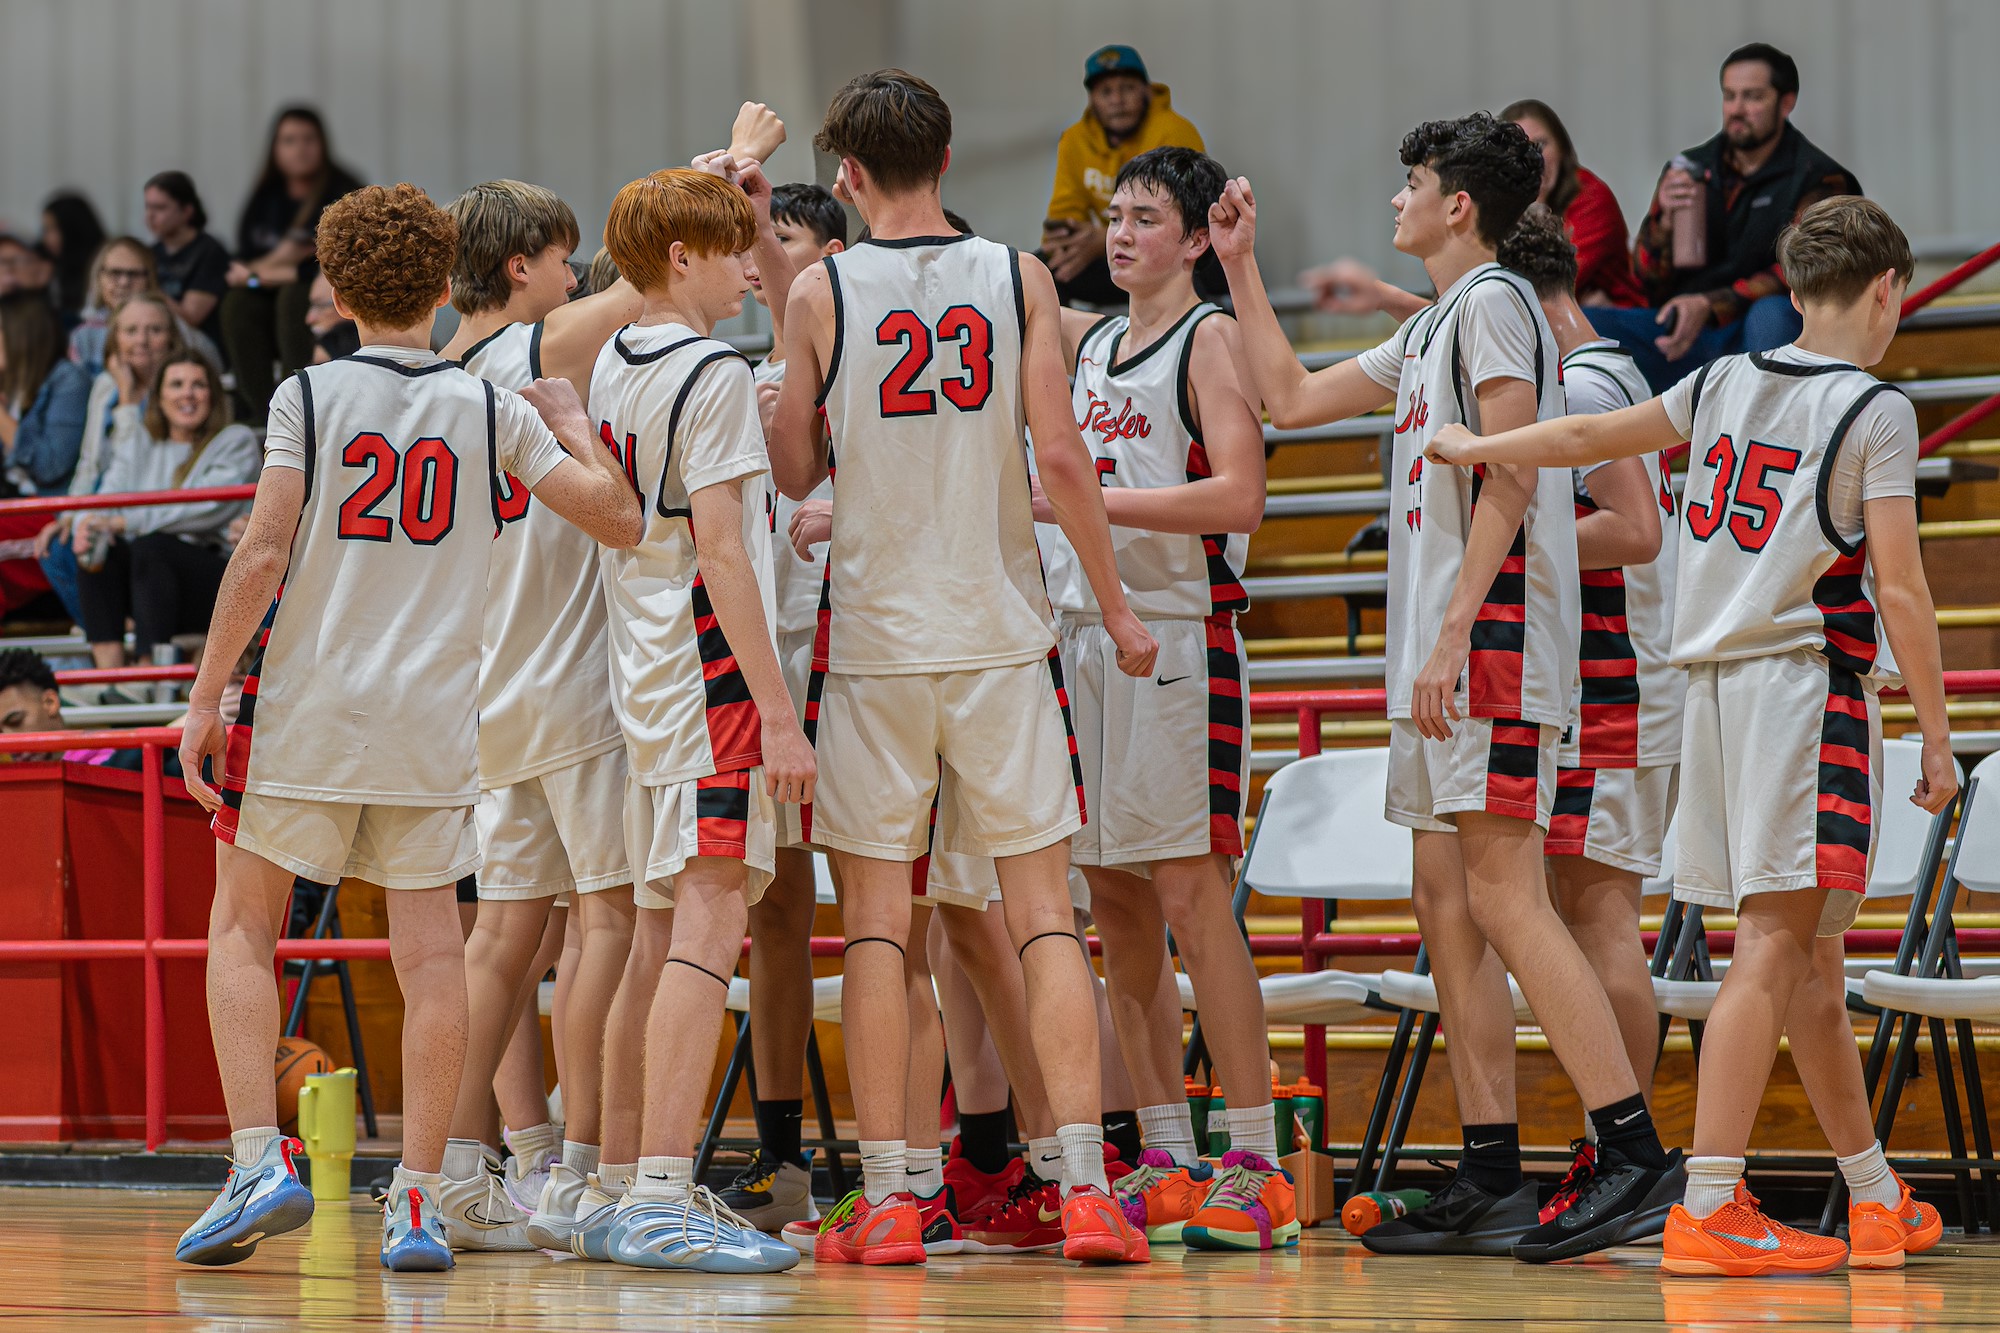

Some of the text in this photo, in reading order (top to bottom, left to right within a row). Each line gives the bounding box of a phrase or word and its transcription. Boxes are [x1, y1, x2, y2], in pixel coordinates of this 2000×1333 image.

[876, 304, 994, 418] 23
[337, 431, 459, 546] 20
[1686, 432, 1803, 554] 35
